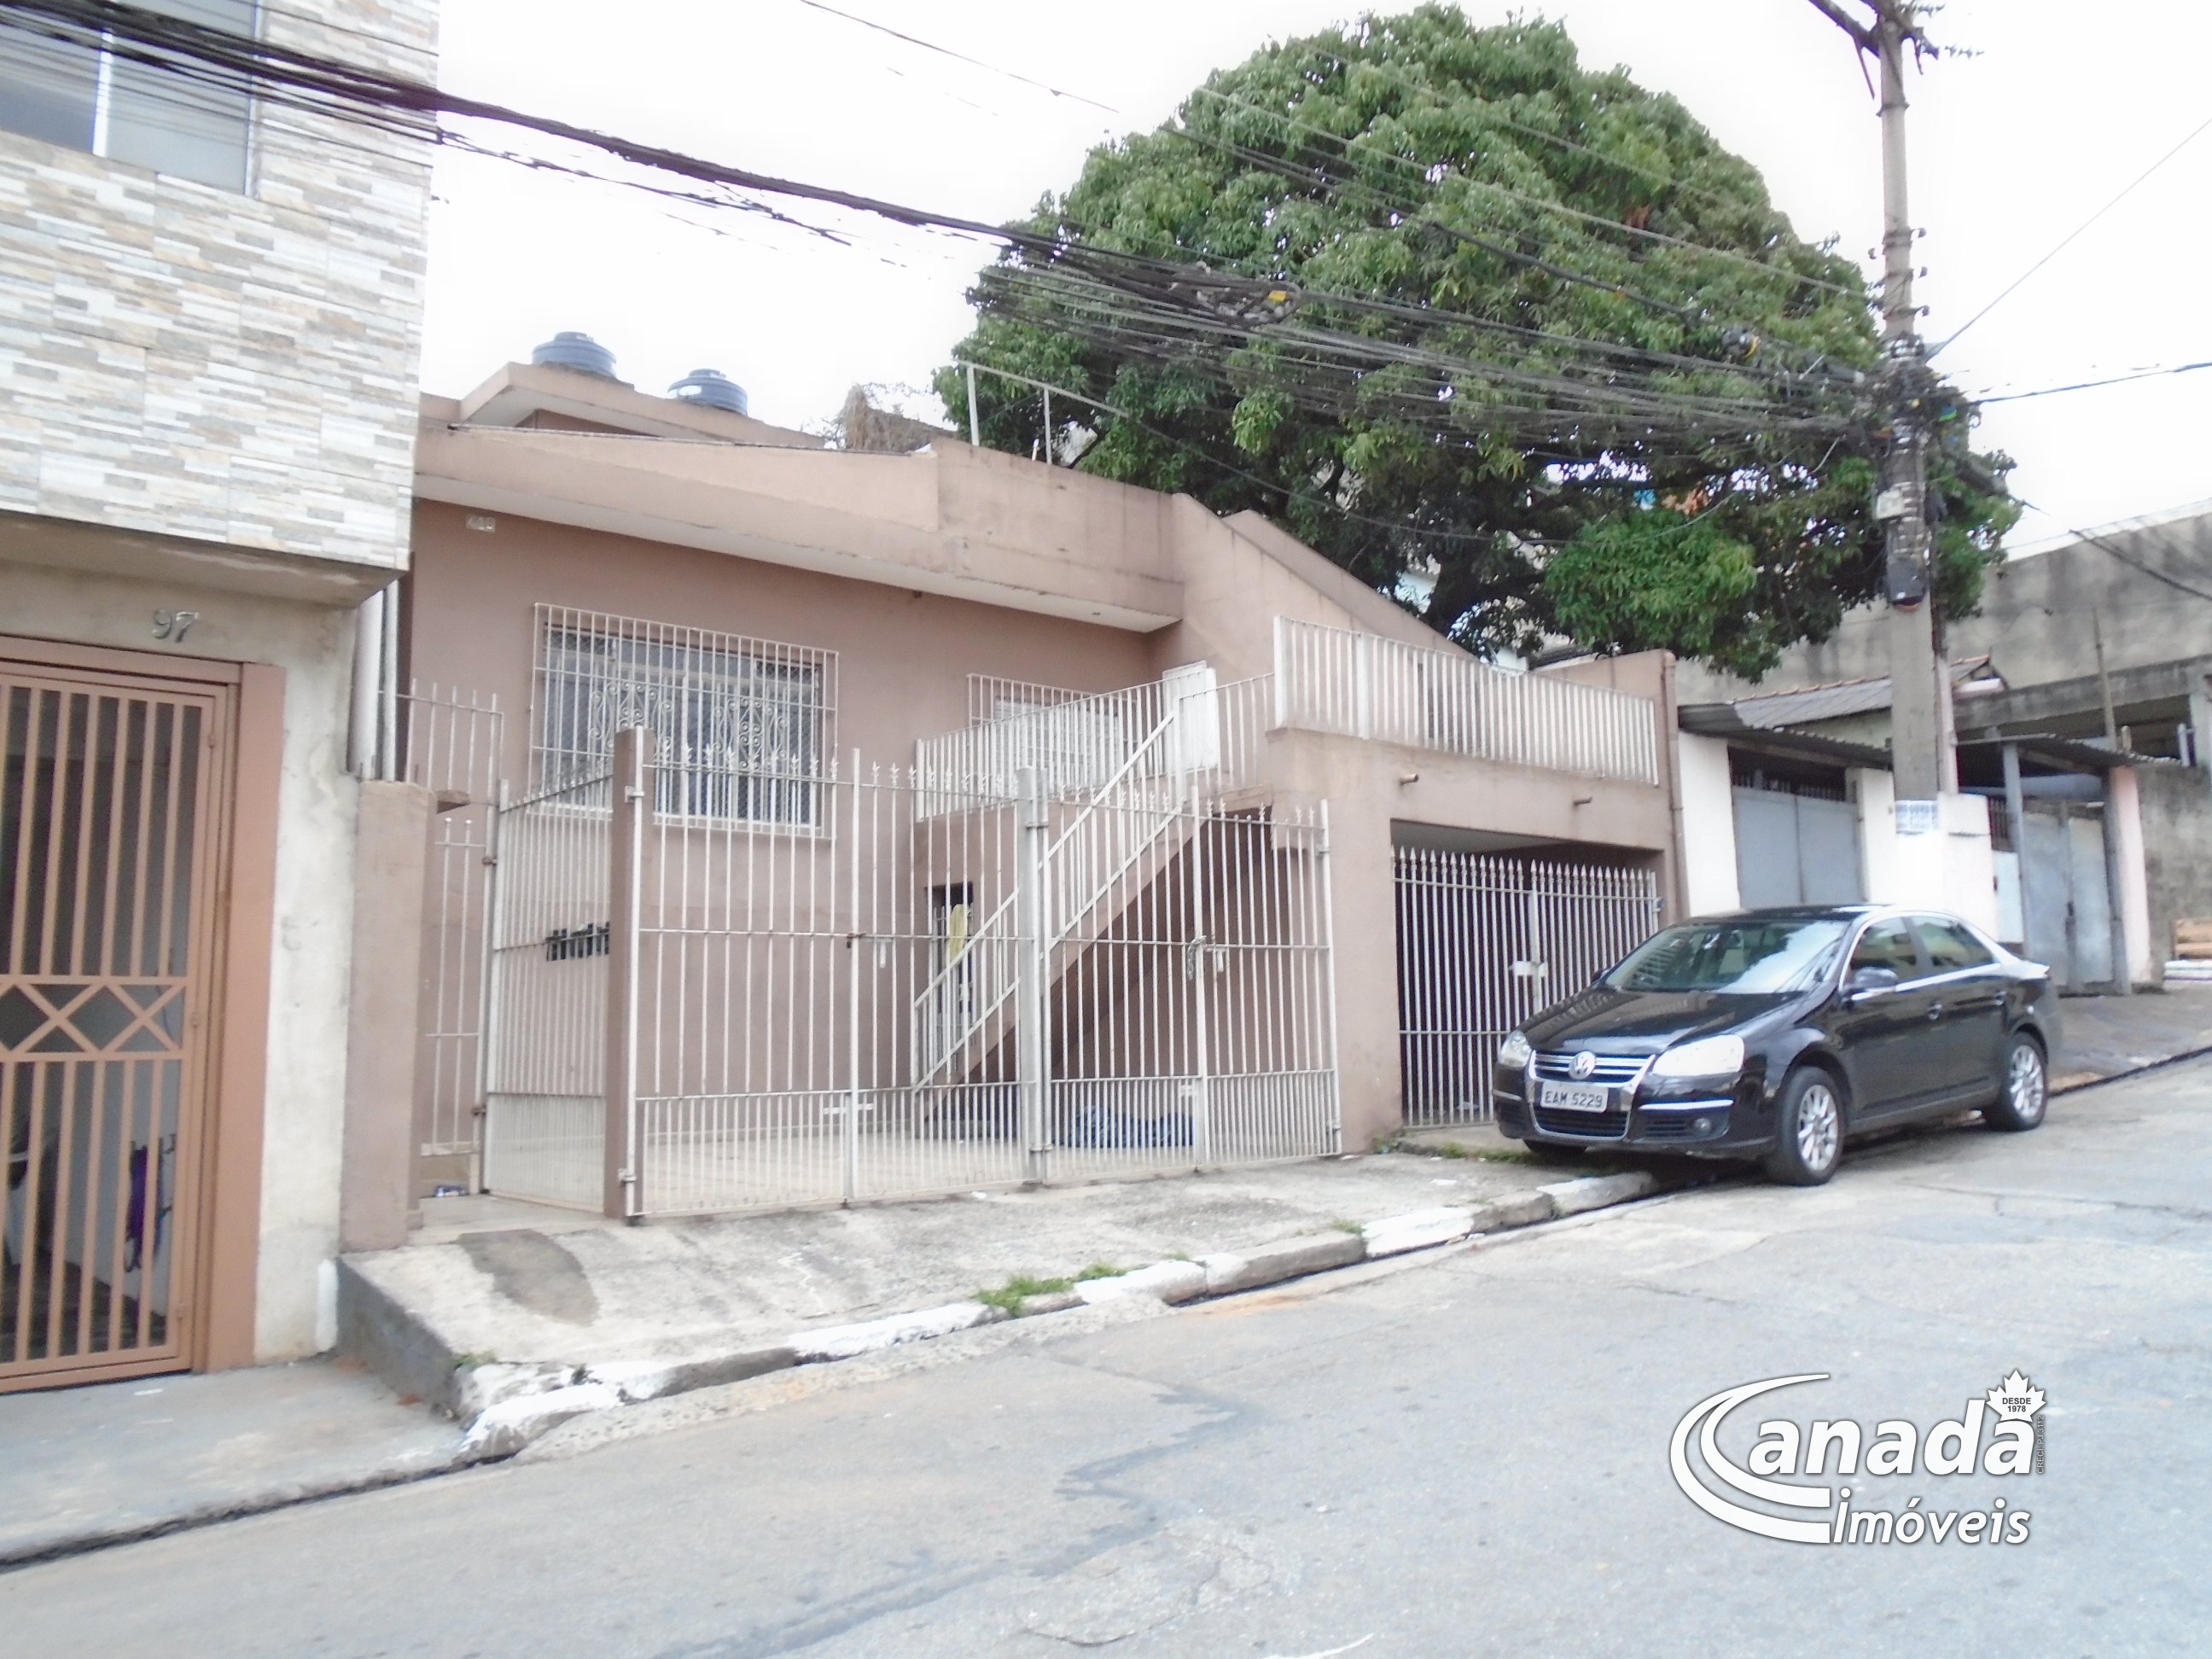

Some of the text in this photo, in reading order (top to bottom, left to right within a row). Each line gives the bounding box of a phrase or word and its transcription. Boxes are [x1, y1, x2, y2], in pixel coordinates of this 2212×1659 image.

[152, 608, 199, 643] 97
[1545, 1091, 1604, 1108] EAM 5229
